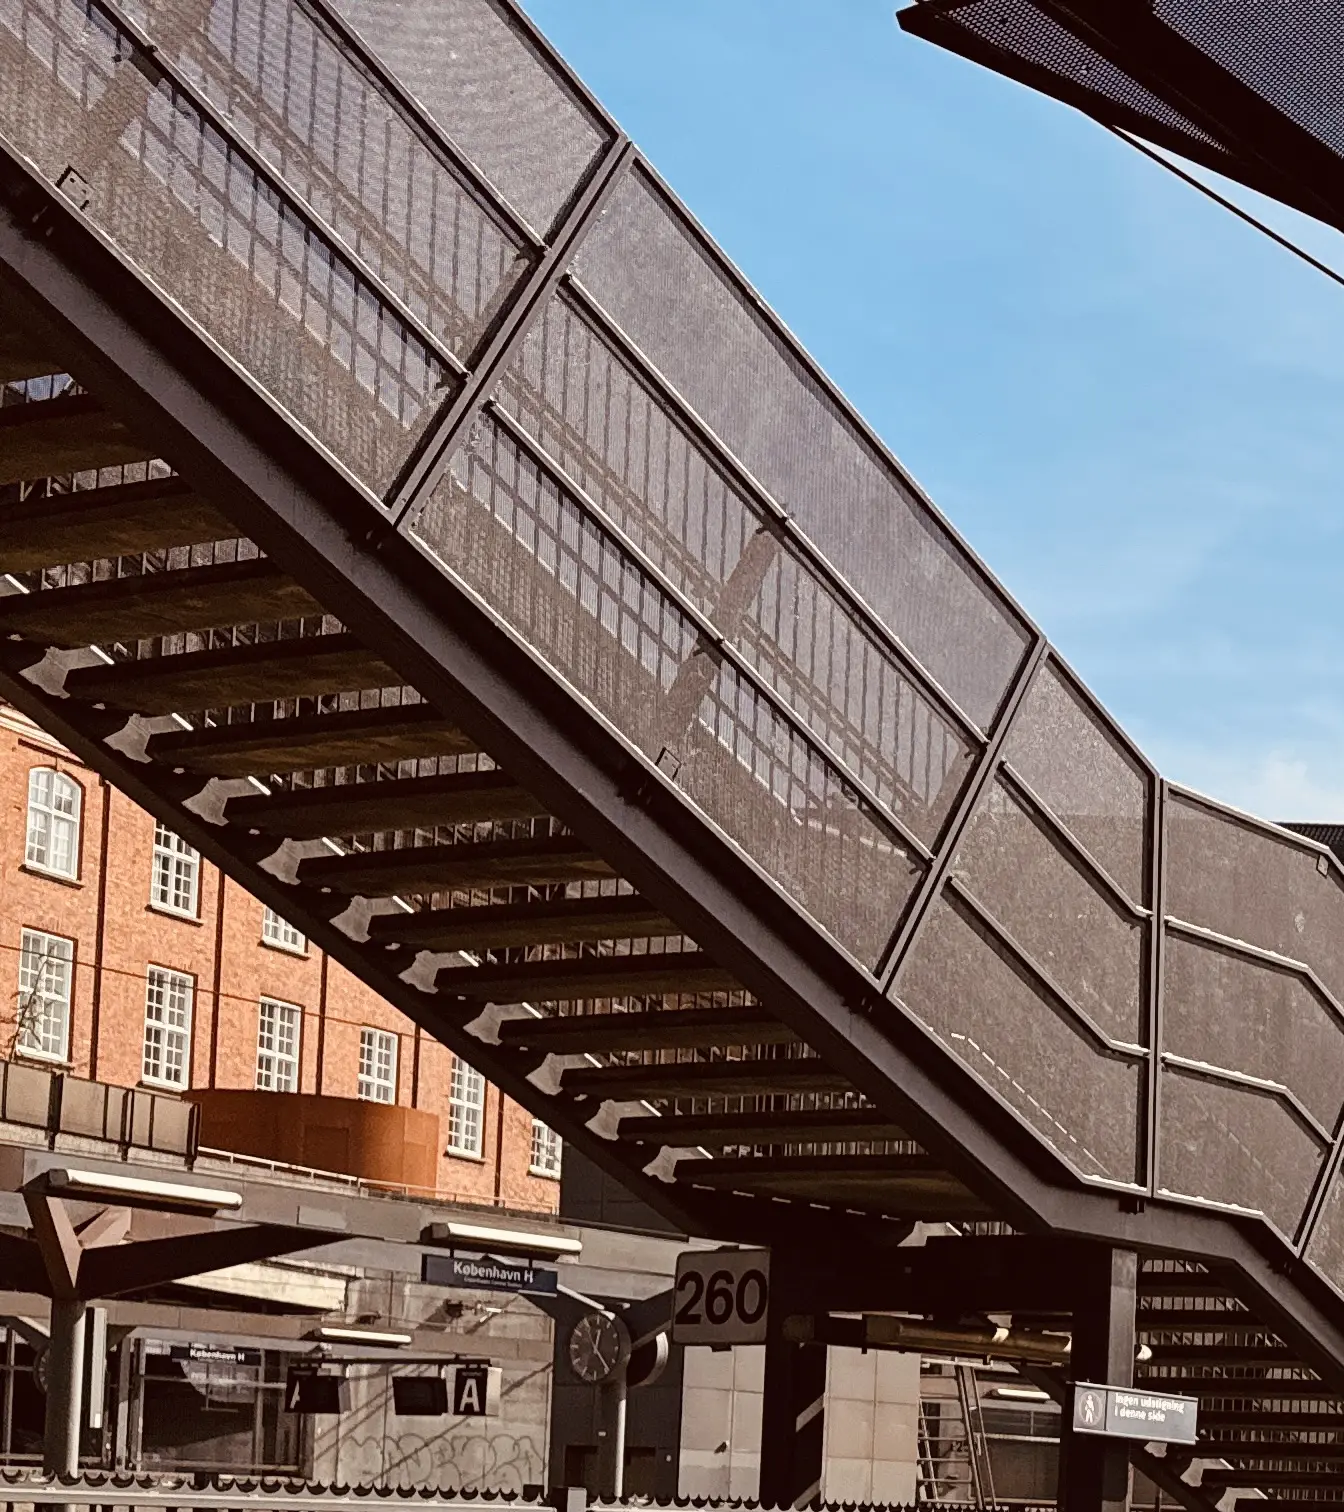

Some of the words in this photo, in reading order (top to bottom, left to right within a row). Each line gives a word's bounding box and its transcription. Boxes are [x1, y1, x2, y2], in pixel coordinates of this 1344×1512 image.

[453, 1261, 521, 1281] København
[524, 1270, 533, 1284] H
[675, 1269, 768, 1325] 260
[459, 1378, 481, 1412] A
[1115, 1392, 1139, 1407] Ingen
[1119, 1406, 1147, 1421] denne
[1147, 1409, 1166, 1423] side
